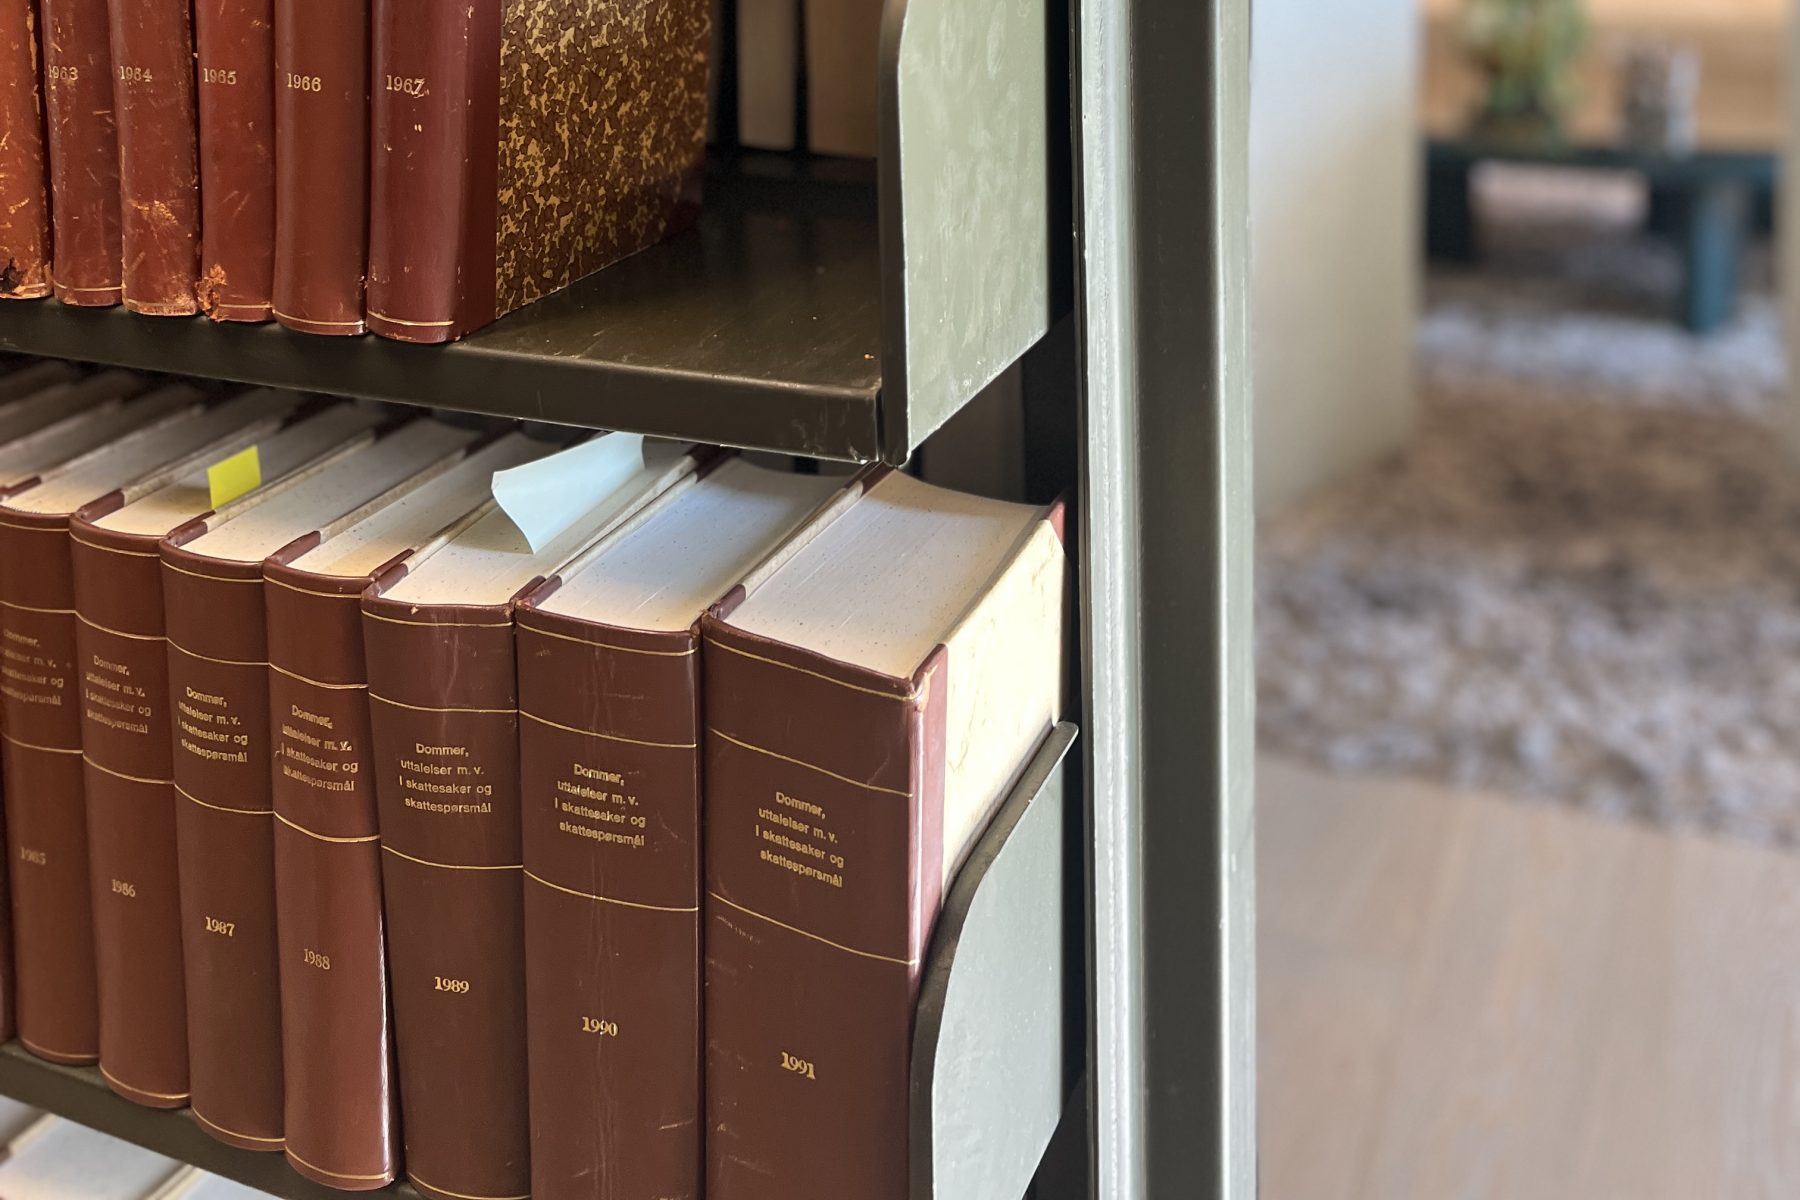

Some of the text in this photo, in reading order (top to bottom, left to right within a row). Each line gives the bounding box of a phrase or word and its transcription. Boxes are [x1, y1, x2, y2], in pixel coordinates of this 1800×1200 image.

[48, 64, 79, 80] 1963
[119, 65, 152, 82] 1964
[203, 68, 237, 85] 1965
[286, 73, 322, 92] 1966
[186, 686, 228, 708] Dommer,
[138, 706, 152, 717] og
[233, 734, 249, 746] og
[415, 742, 469, 758] Dommer,
[342, 761, 360, 775] og
[400, 759, 453, 776] uttalelser
[573, 763, 625, 787] Dommer,
[405, 780, 472, 795] skattesaker
[476, 785, 492, 796] og
[557, 780, 608, 803] uttalelser
[404, 797, 492, 815] skattespørsmål
[561, 801, 626, 825] skattesaker
[630, 816, 647, 829] og
[775, 791, 826, 820] Dommer,
[758, 807, 810, 835] uttalelser
[559, 821, 646, 848] skattespørsmål
[762, 830, 826, 860] skattesaker
[829, 854, 845, 869] og
[760, 850, 843, 888] skattespørsmål
[111, 878, 136, 898] 1986
[205, 916, 236, 937] 1987
[303, 948, 331, 970] 1988
[434, 976, 469, 995] 1989
[582, 1016, 619, 1038] 1990
[780, 1051, 816, 1080] 1991
